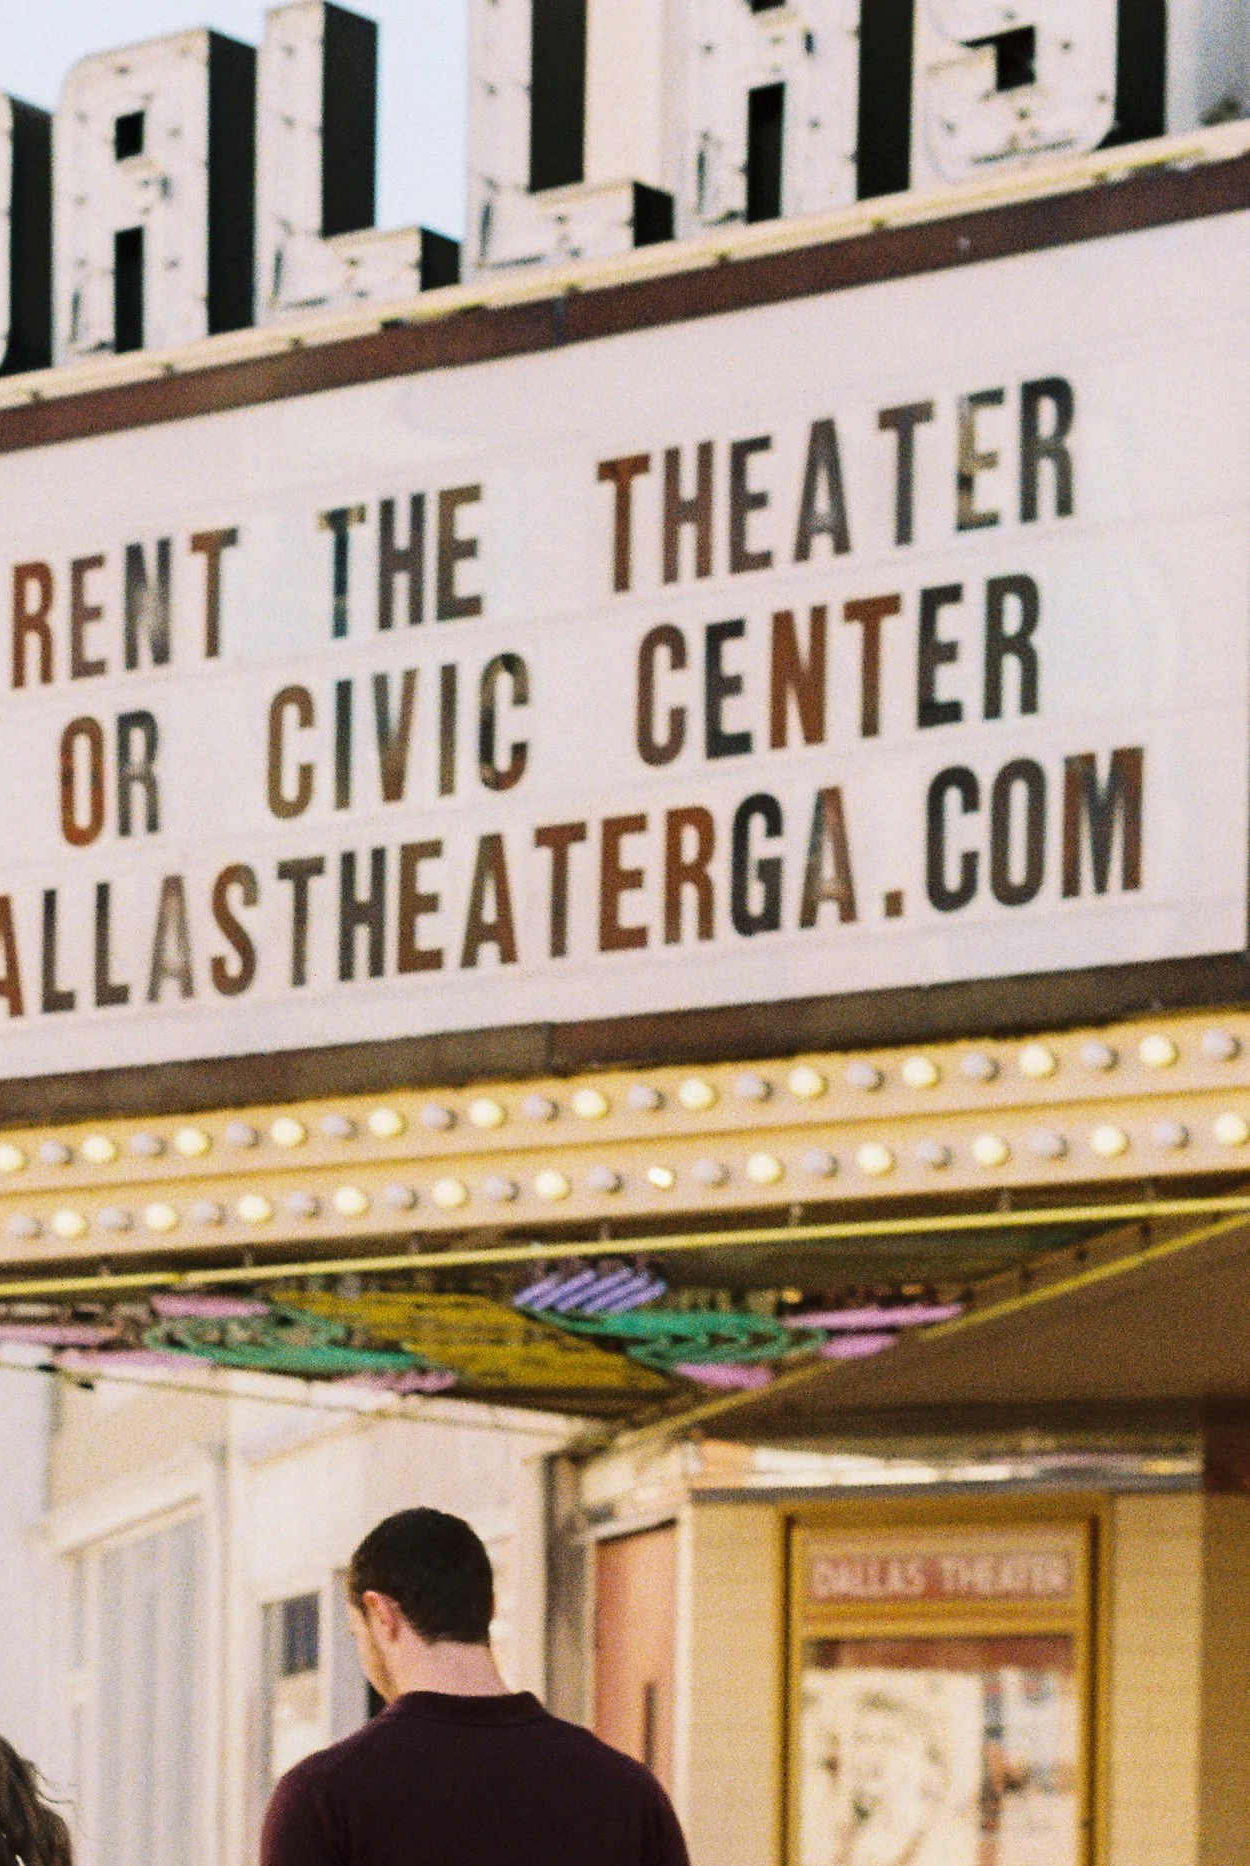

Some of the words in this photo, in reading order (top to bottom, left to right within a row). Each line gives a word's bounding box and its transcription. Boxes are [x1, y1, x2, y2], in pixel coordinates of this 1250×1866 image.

[11, 526, 239, 689] RENT
[318, 484, 484, 640] THE
[596, 375, 1076, 594] THEATER
[60, 709, 163, 847] OR
[266, 651, 531, 820] CIVIC
[635, 572, 1042, 767] CENTER
[811, 1557, 925, 1598] DALLAS
[939, 1554, 1070, 1595] THEATER
